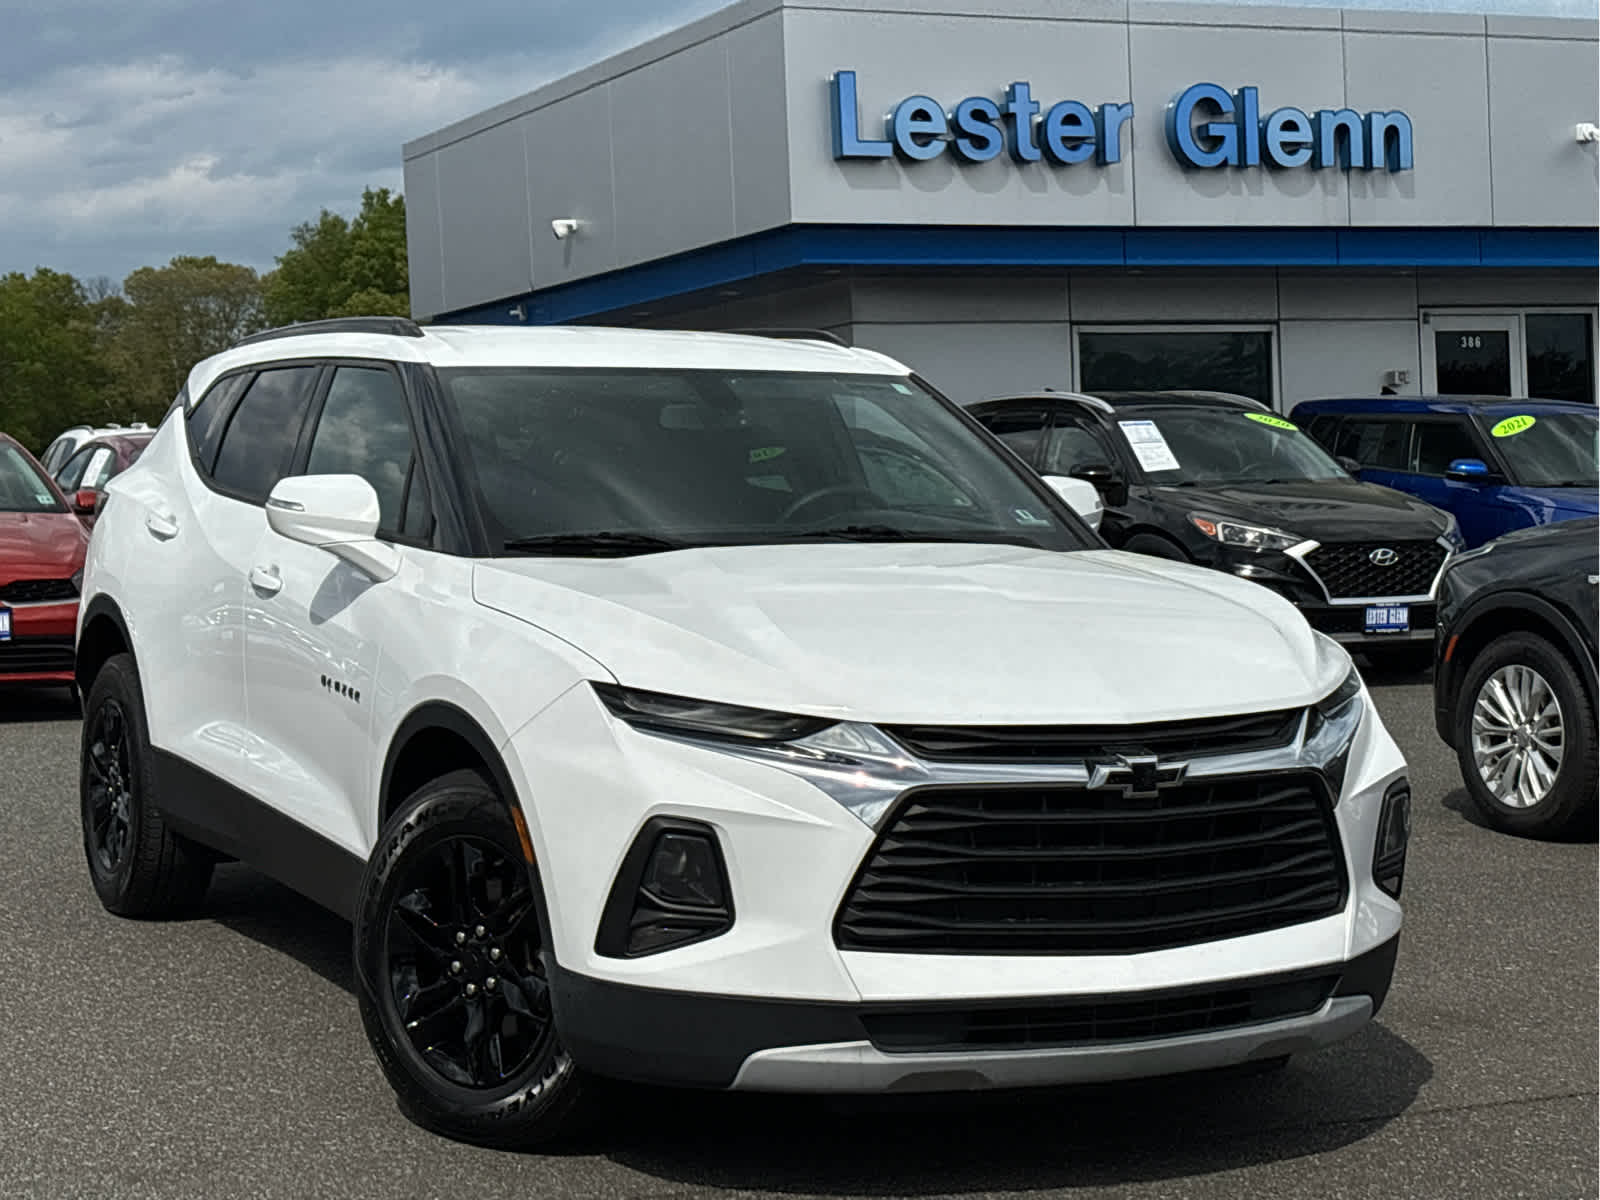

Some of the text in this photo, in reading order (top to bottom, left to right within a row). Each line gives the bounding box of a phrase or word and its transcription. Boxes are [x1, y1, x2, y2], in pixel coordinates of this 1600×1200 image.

[830, 70, 1414, 172] Lester Glenn
[1499, 416, 1527, 434] 2021
